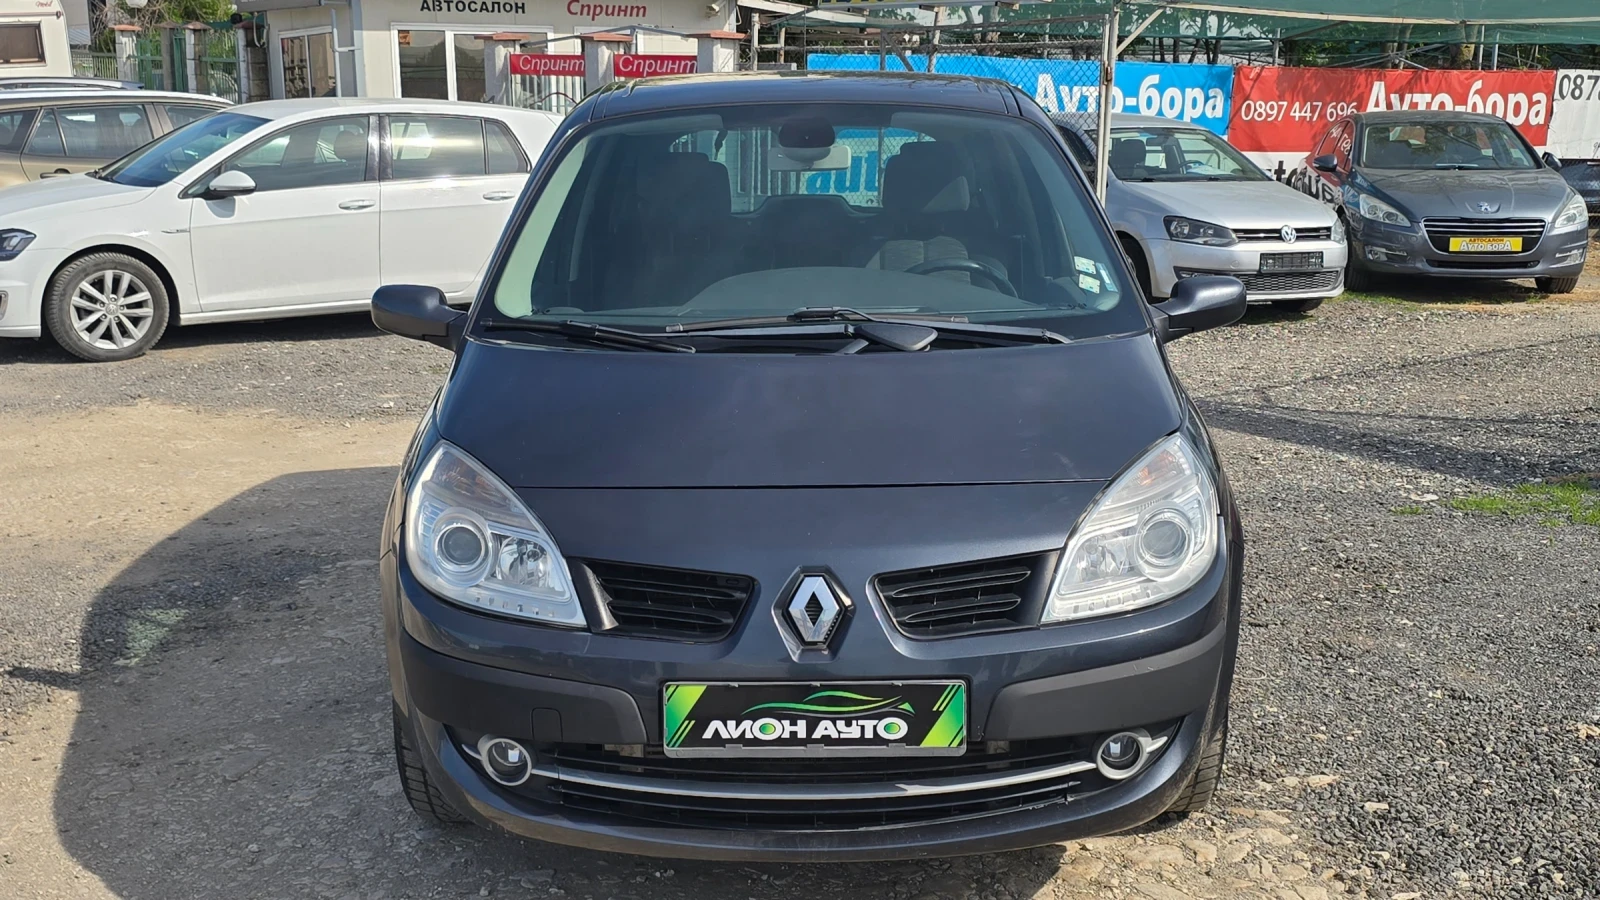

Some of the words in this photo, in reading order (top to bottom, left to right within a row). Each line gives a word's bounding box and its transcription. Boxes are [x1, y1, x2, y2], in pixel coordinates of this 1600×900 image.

[420, 0, 526, 14] АВТОСАЛОН
[567, 0, 647, 21] Спринт
[519, 55, 585, 75] Спринт
[619, 55, 697, 77] Спринт
[1559, 74, 1600, 101] 087
[1241, 100, 1288, 121] 0897
[1290, 101, 1322, 121] 447
[702, 718, 806, 740] ЛИОН
[811, 717, 908, 740] АУТО
